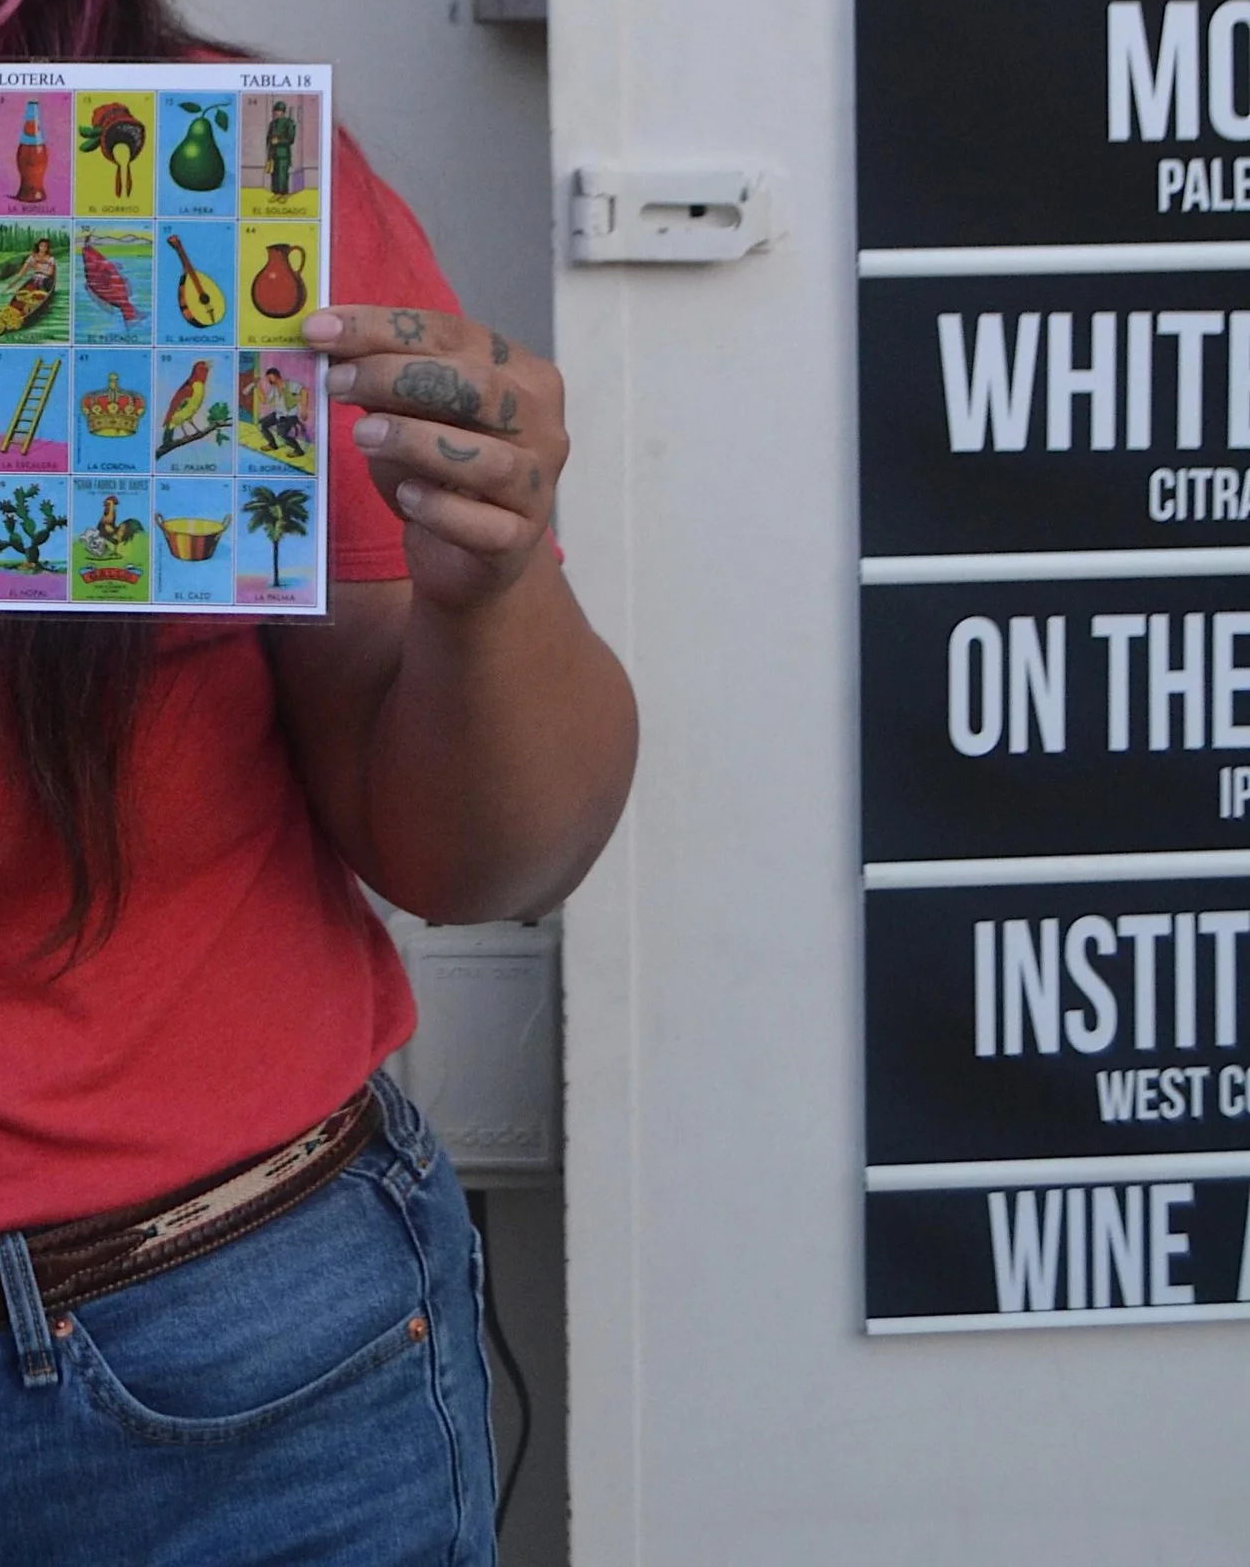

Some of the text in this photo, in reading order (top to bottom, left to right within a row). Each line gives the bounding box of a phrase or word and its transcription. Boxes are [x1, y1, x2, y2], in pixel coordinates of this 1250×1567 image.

[240, 74, 311, 87] TABLA 18
[949, 617, 1065, 756] ON
[976, 911, 1250, 1056] INSTIT
[1097, 1068, 1209, 1120] WEST
[988, 1183, 1196, 1312] WINE
